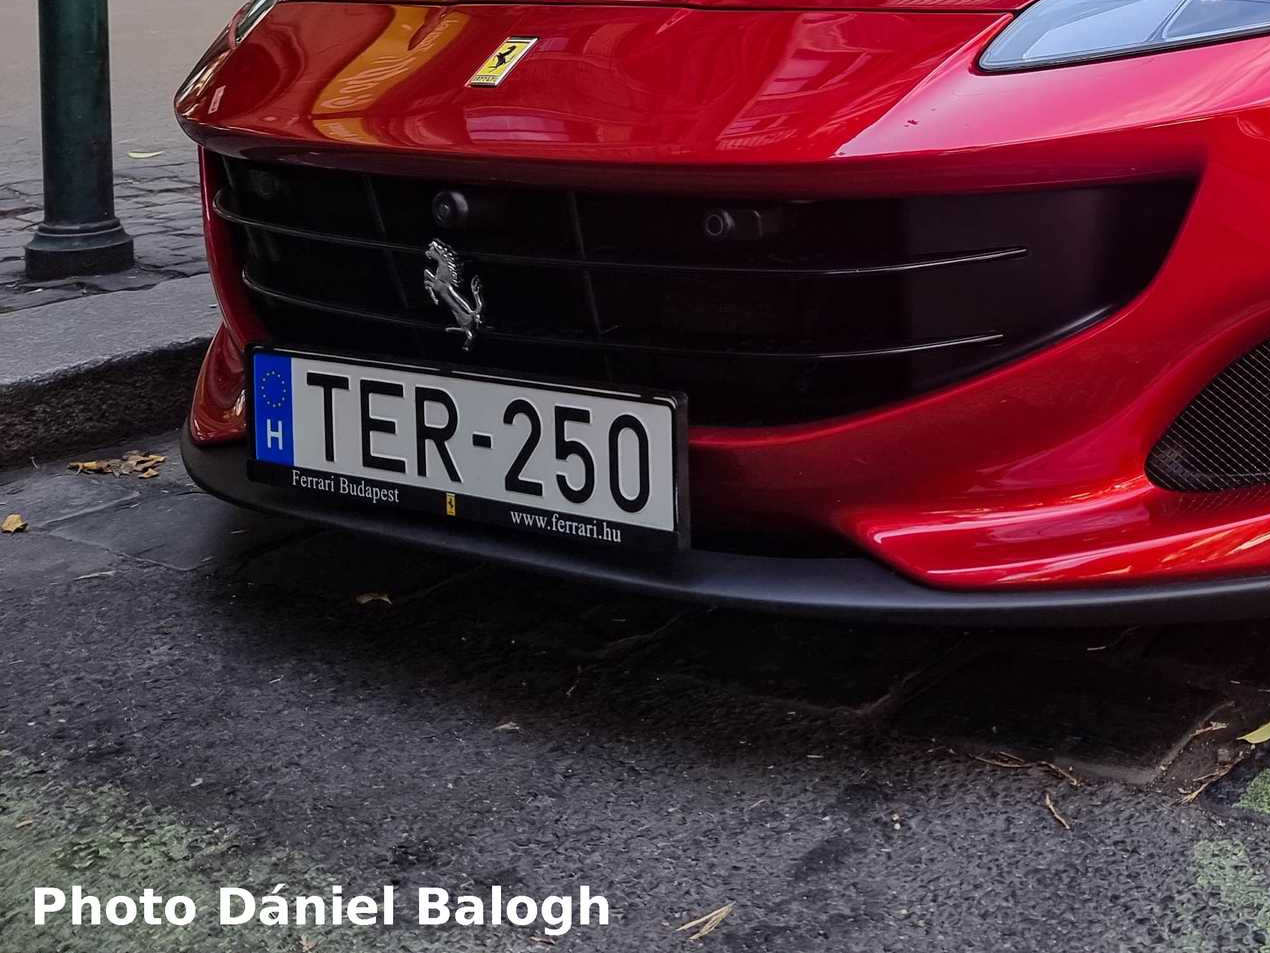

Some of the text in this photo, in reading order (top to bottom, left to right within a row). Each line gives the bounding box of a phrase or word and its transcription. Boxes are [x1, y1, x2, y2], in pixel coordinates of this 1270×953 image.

[266, 419, 283, 450] H
[307, 372, 651, 513] TER-250
[292, 469, 400, 504] Ferrari Budapest
[510, 510, 621, 543] www.ferrari.hu
